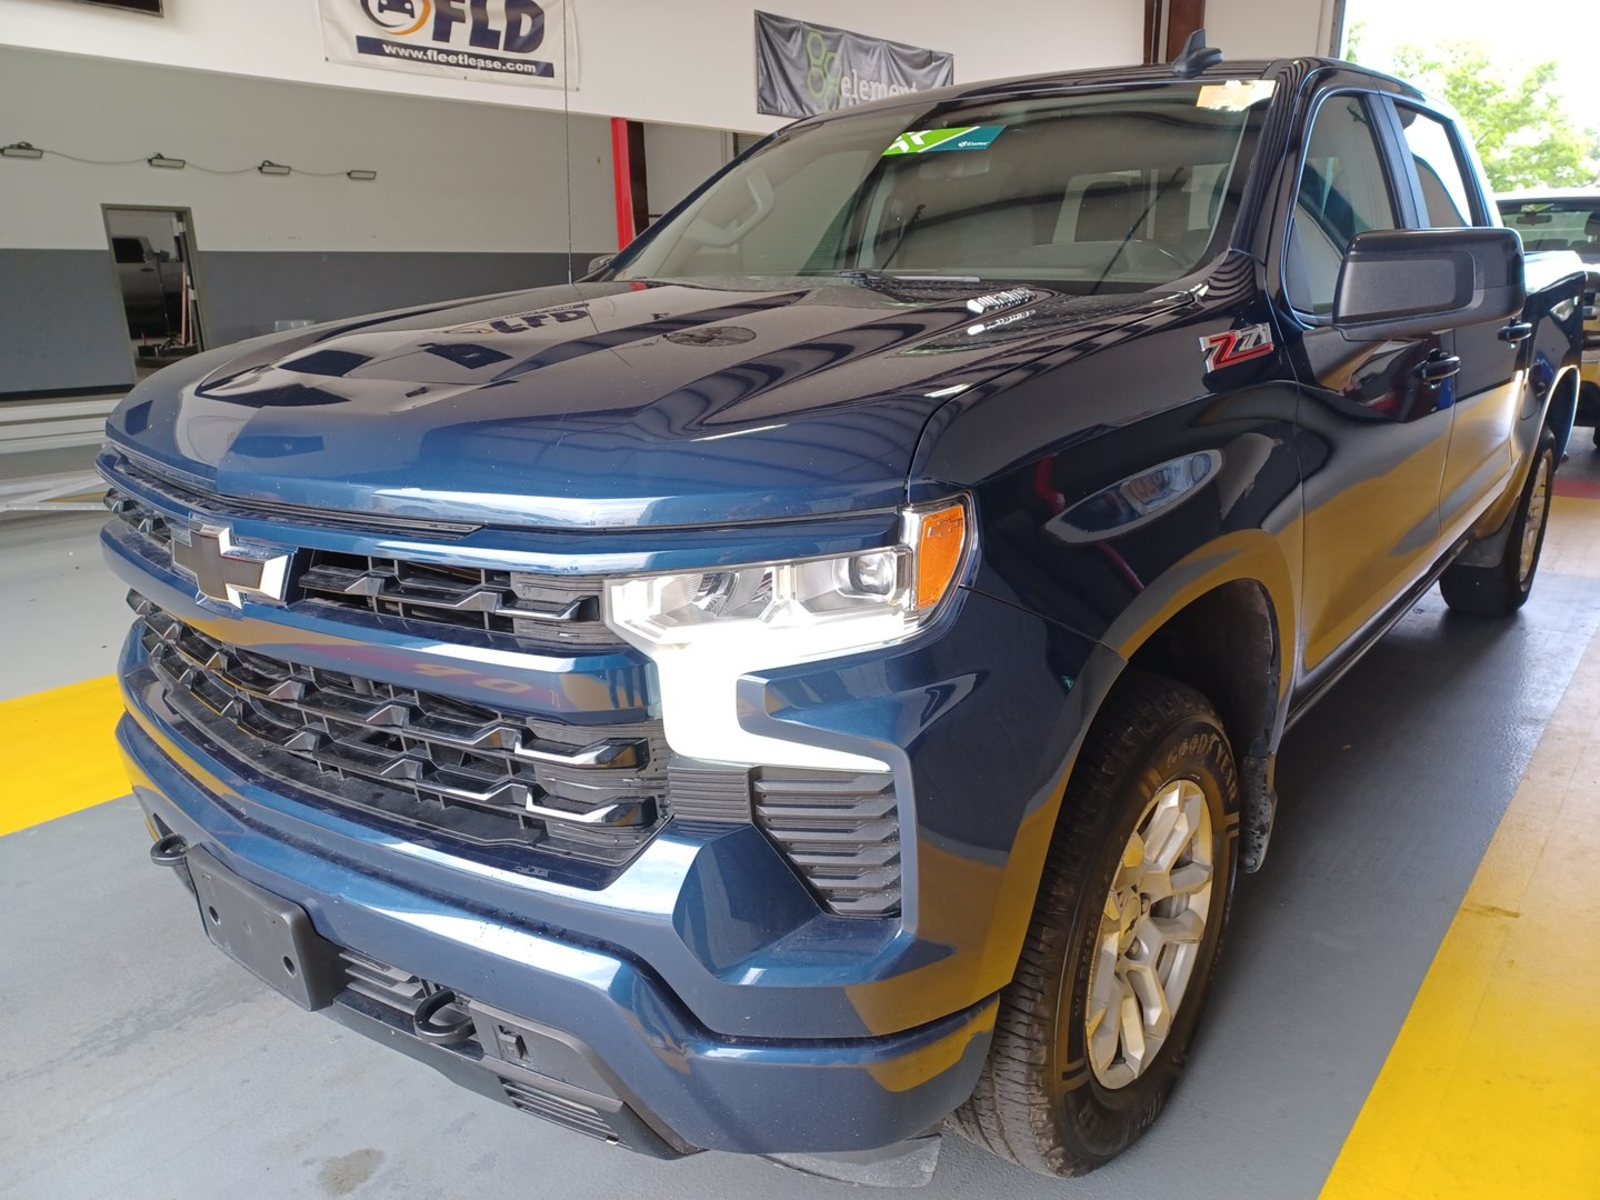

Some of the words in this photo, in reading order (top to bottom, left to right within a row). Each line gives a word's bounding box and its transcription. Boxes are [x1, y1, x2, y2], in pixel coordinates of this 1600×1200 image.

[432, 0, 544, 53] FLD
[382, 44, 537, 73] www.fleetlease.com
[1198, 322, 1275, 373] Z71
